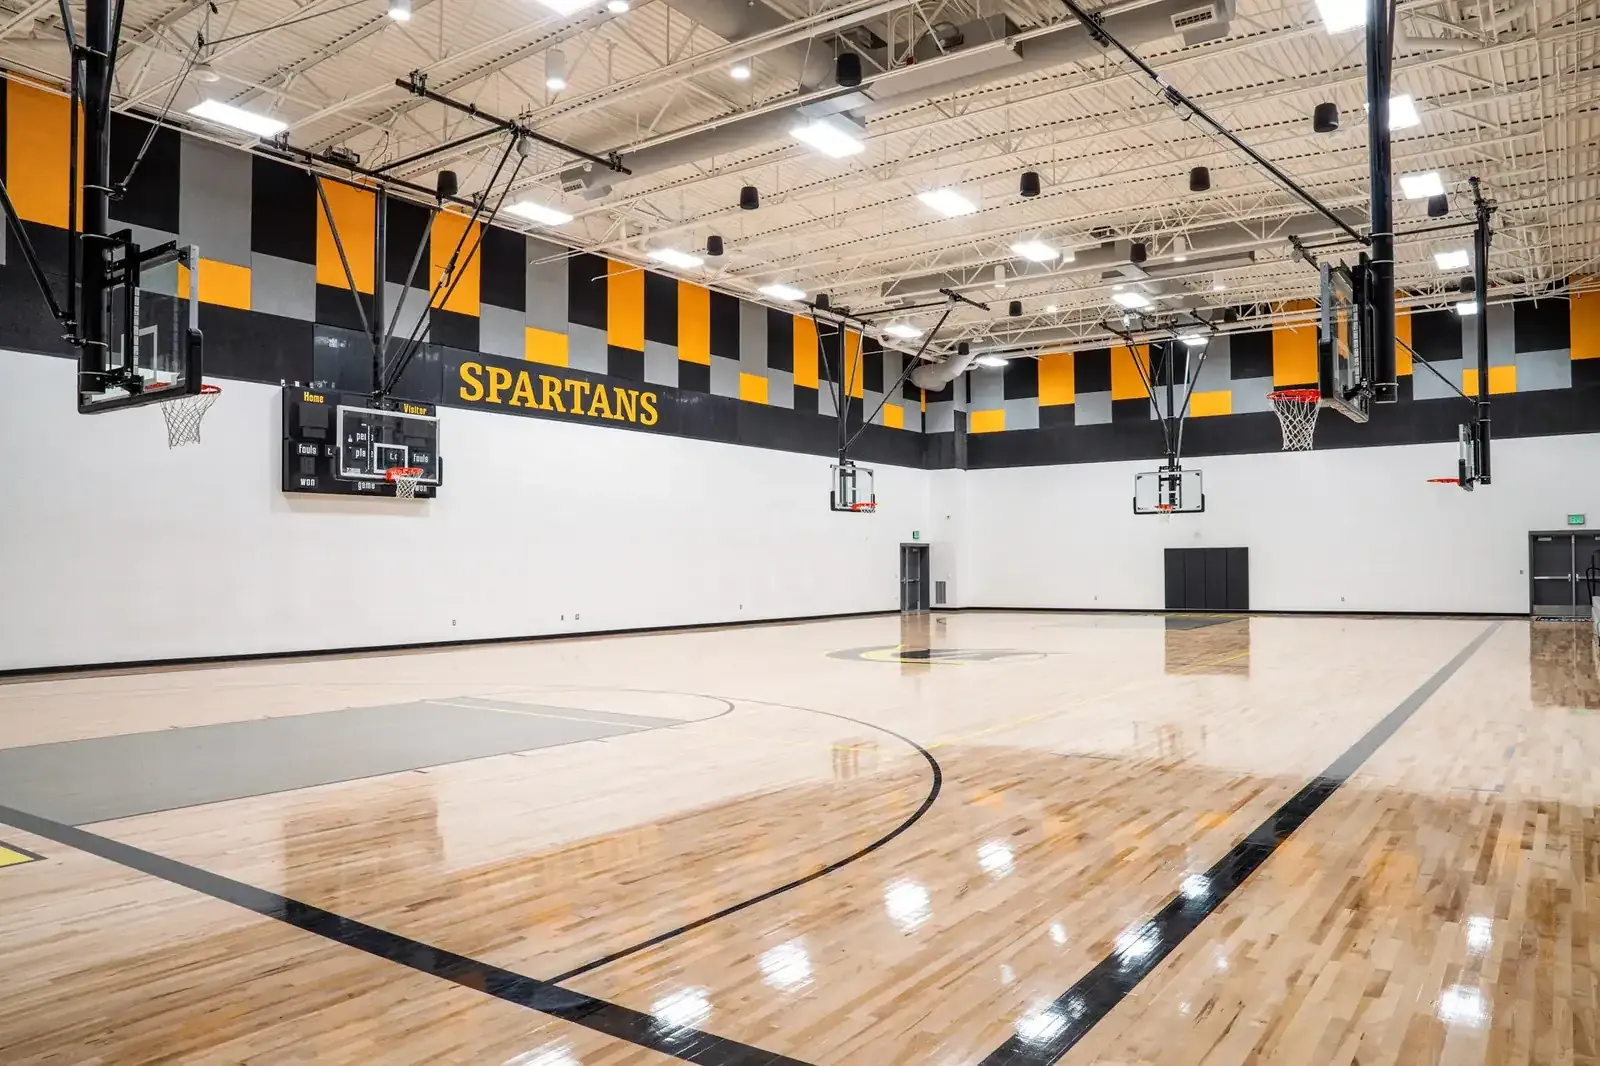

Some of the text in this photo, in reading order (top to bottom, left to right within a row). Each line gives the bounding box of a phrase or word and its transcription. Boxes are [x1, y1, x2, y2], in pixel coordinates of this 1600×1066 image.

[304, 392, 324, 404] Home
[459, 361, 659, 426] SPARTANS
[404, 404, 427, 415] Visitor
[298, 444, 316, 455] fouls
[300, 477, 316, 487] won
[357, 481, 376, 491] game
